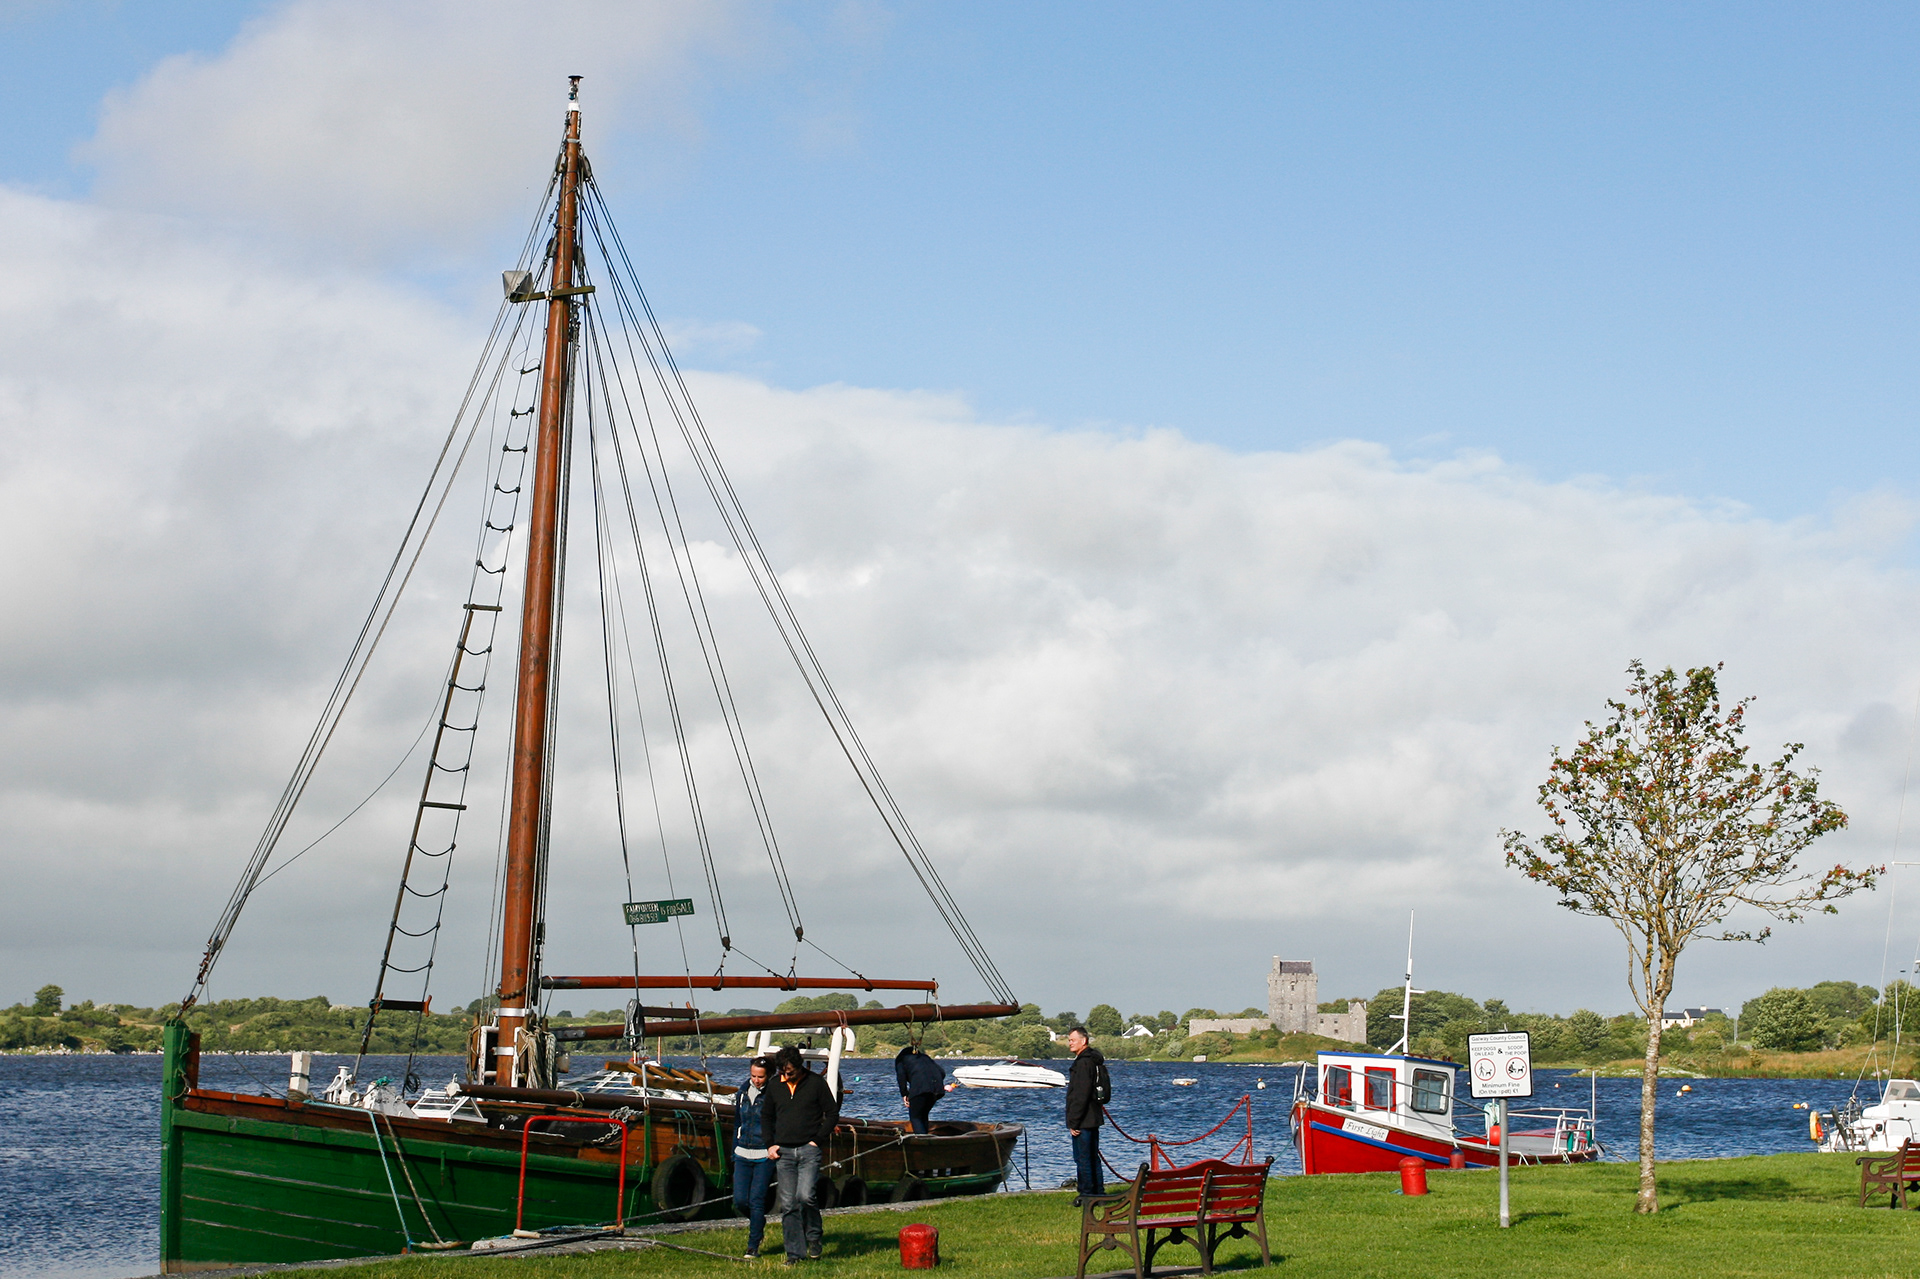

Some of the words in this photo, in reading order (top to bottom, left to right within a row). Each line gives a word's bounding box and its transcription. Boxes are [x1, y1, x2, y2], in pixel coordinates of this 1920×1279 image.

[676, 902, 692, 913] SALE
[1347, 1121, 1364, 1132] First
[1366, 1127, 1384, 1138] Light
